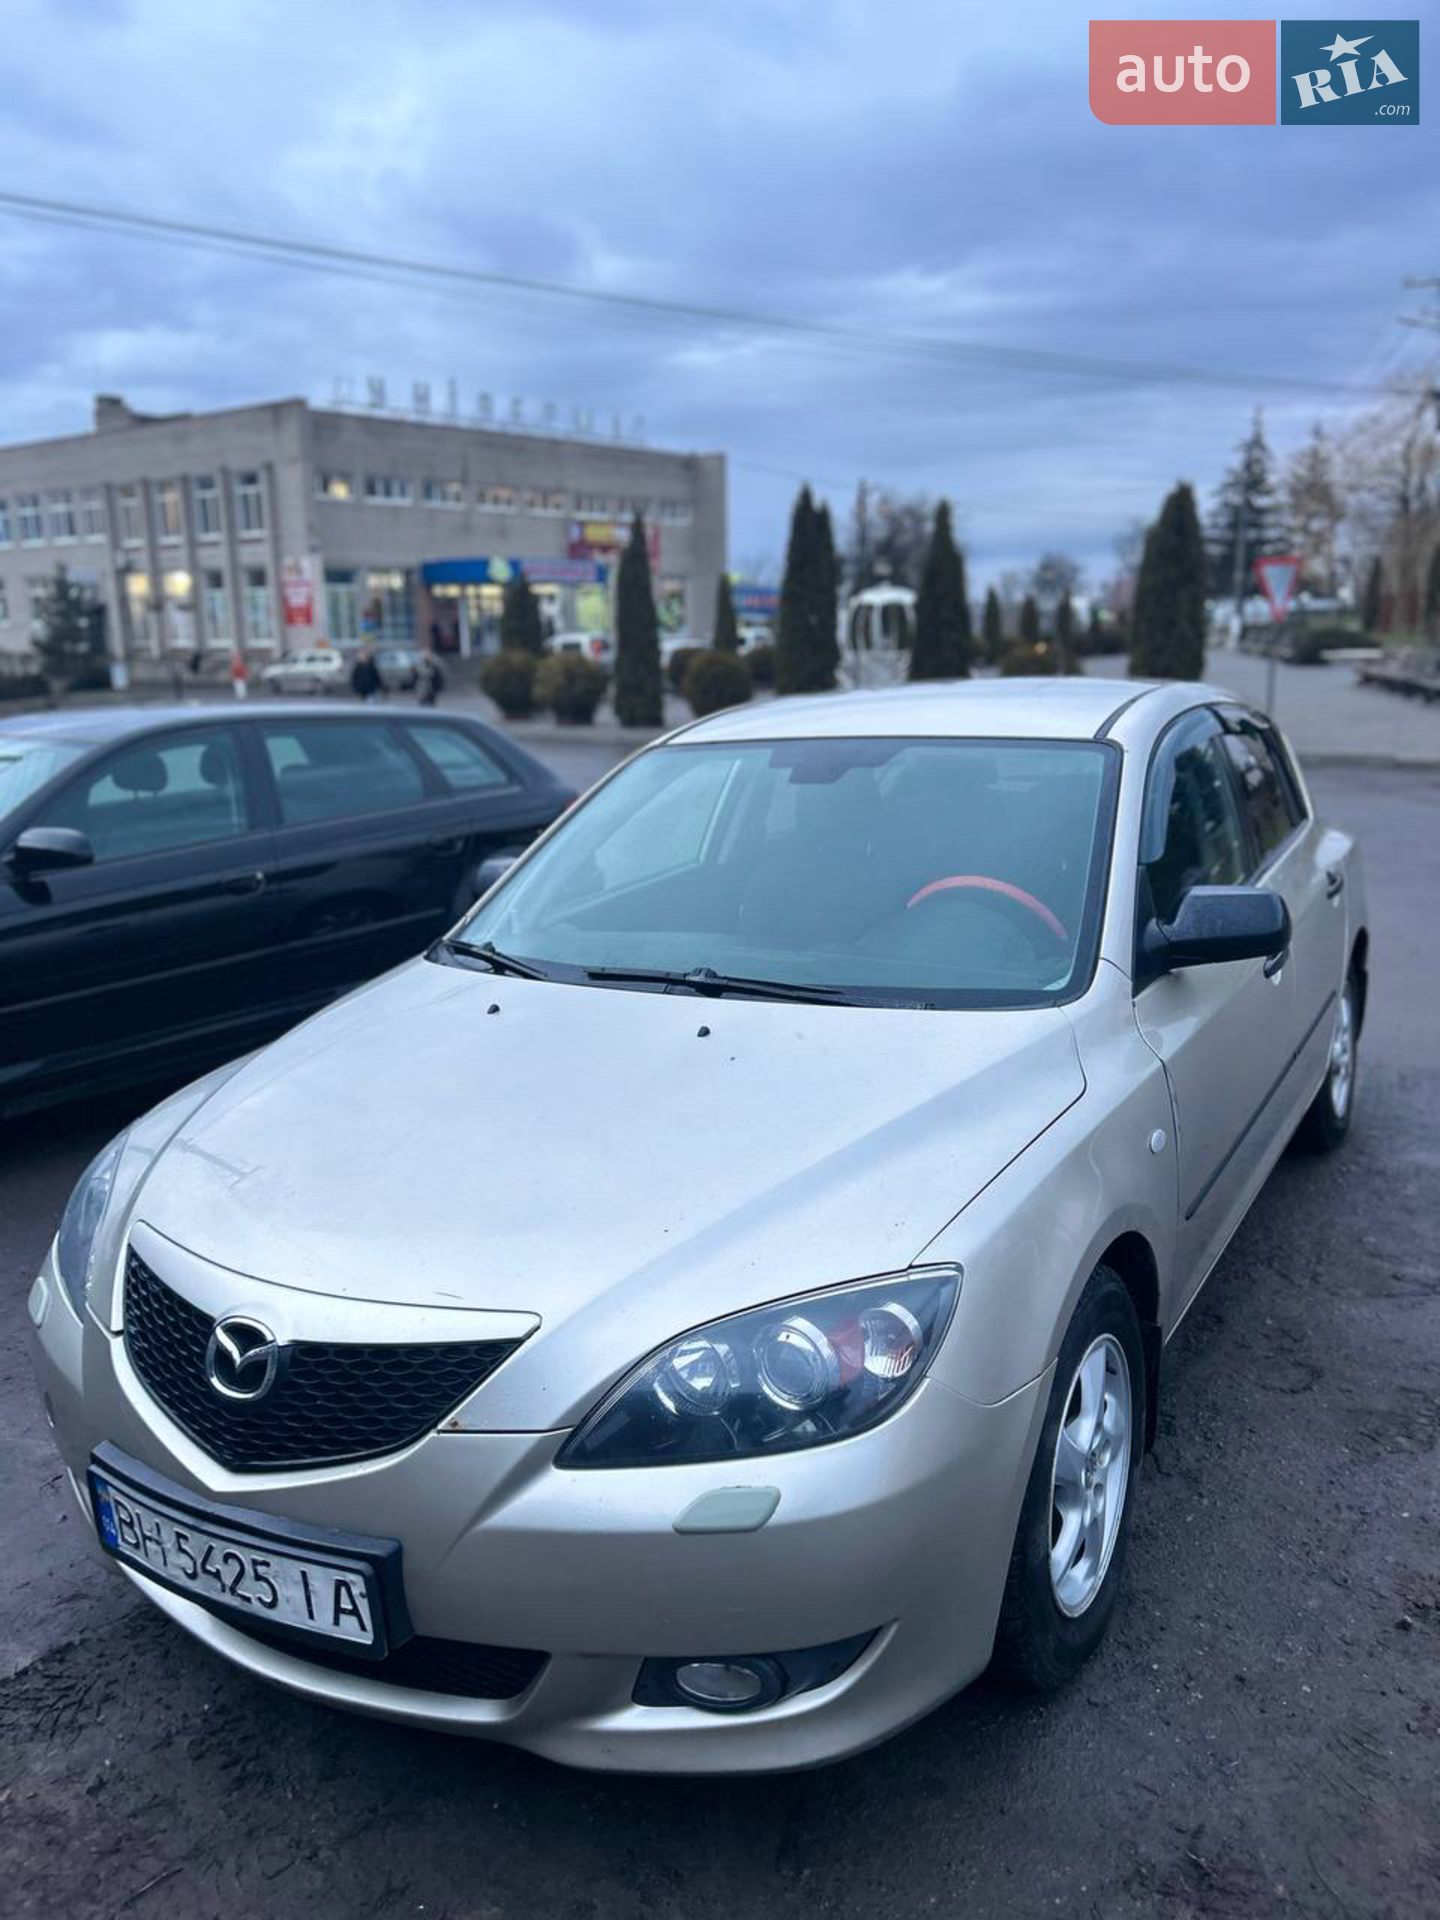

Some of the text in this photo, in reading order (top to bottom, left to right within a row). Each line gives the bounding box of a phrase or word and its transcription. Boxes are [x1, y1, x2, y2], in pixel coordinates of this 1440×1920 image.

[112, 1495, 368, 1632] BH 5425 IA
